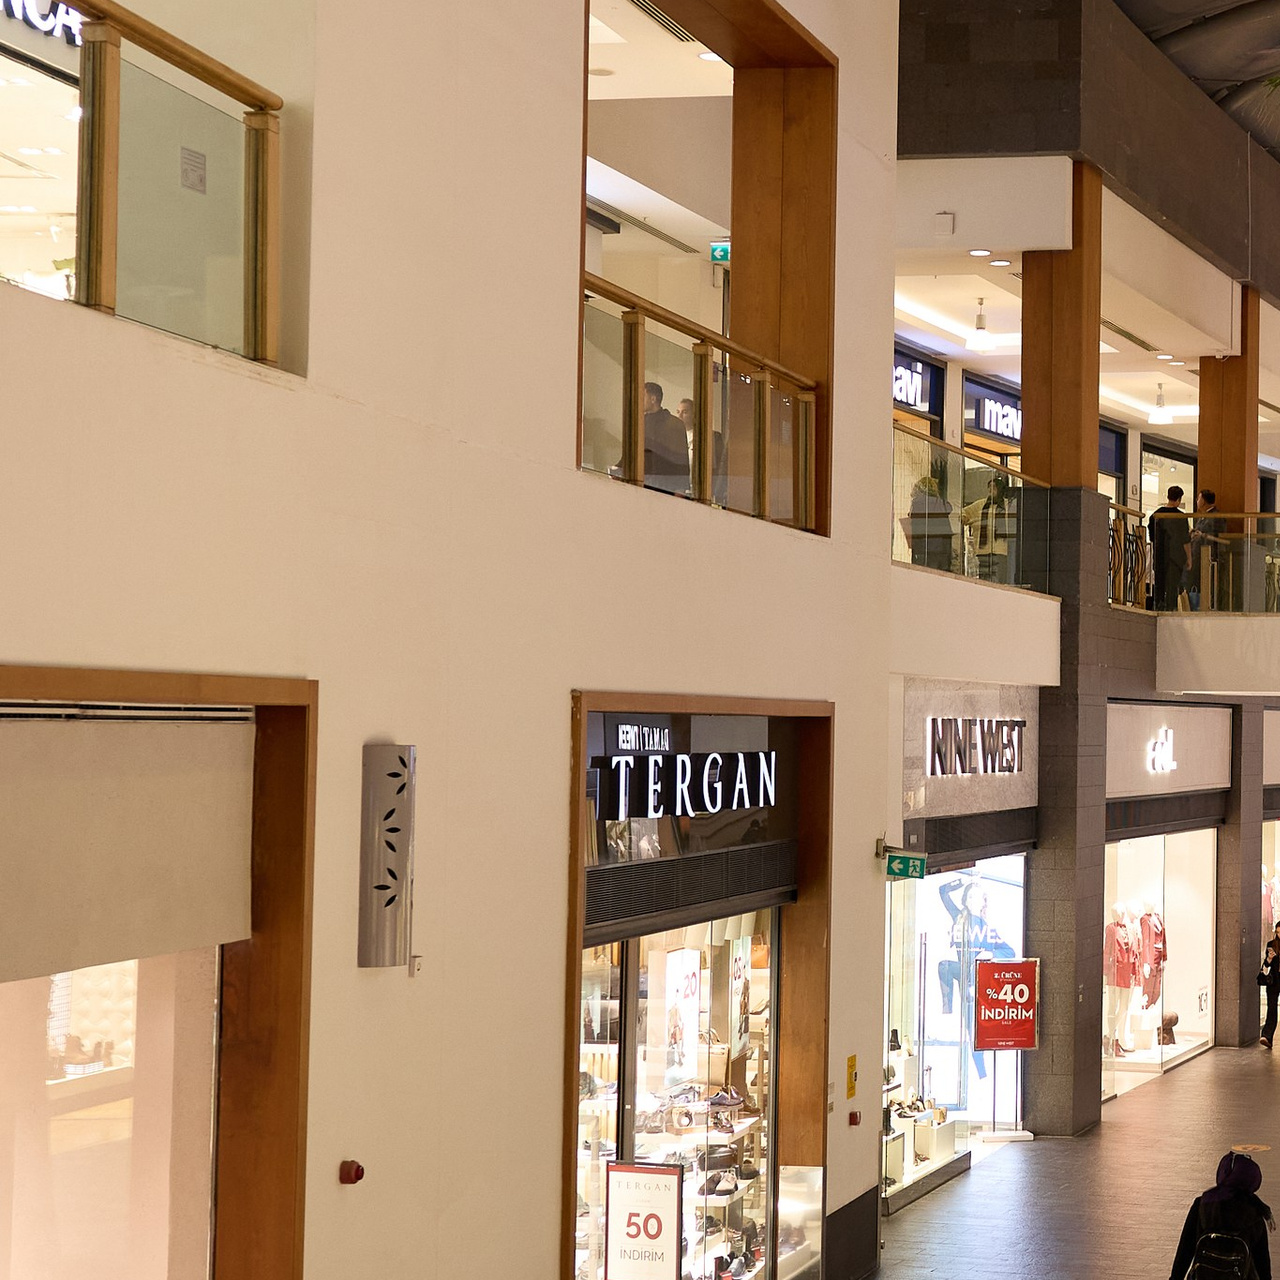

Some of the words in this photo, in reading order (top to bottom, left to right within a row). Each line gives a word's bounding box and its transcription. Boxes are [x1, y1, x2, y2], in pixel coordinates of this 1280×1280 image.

[893, 361, 923, 407] avi
[984, 398, 1022, 440] mav
[978, 718, 1027, 775] WEST
[611, 751, 777, 822] TERGAN
[986, 983, 1030, 1004] %40
[981, 1005, 1034, 1021] İNDİRİM
[616, 1180, 672, 1192] TERGAN
[625, 1212, 663, 1240] 50
[620, 1246, 665, 1262] İNDİRİM
